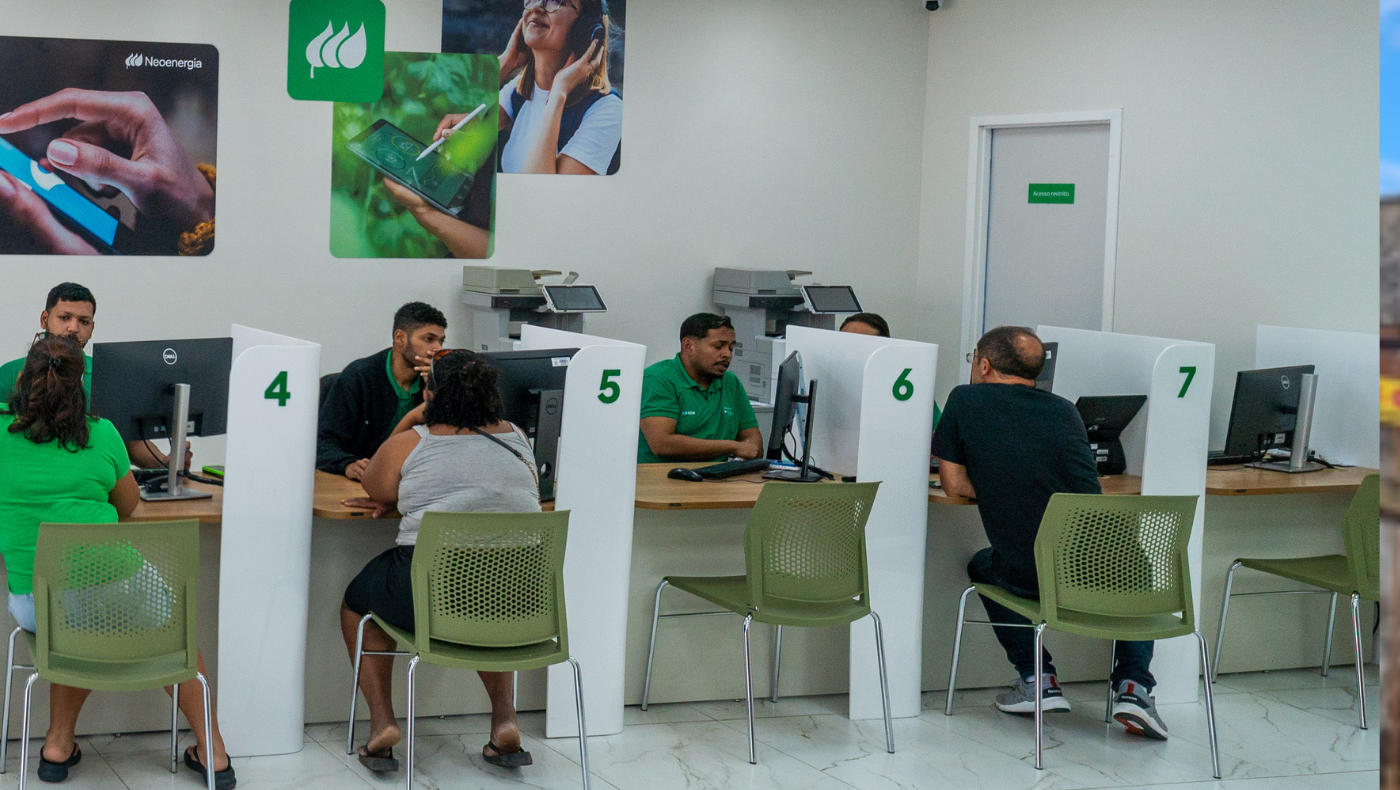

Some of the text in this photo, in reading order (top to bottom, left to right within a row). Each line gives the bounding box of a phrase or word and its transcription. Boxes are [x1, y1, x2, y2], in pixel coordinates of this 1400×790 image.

[144, 56, 203, 70] Neoenergia
[264, 370, 291, 407] 4
[597, 369, 621, 404] 5
[892, 367, 914, 401] 6
[1177, 366, 1197, 398] 7
